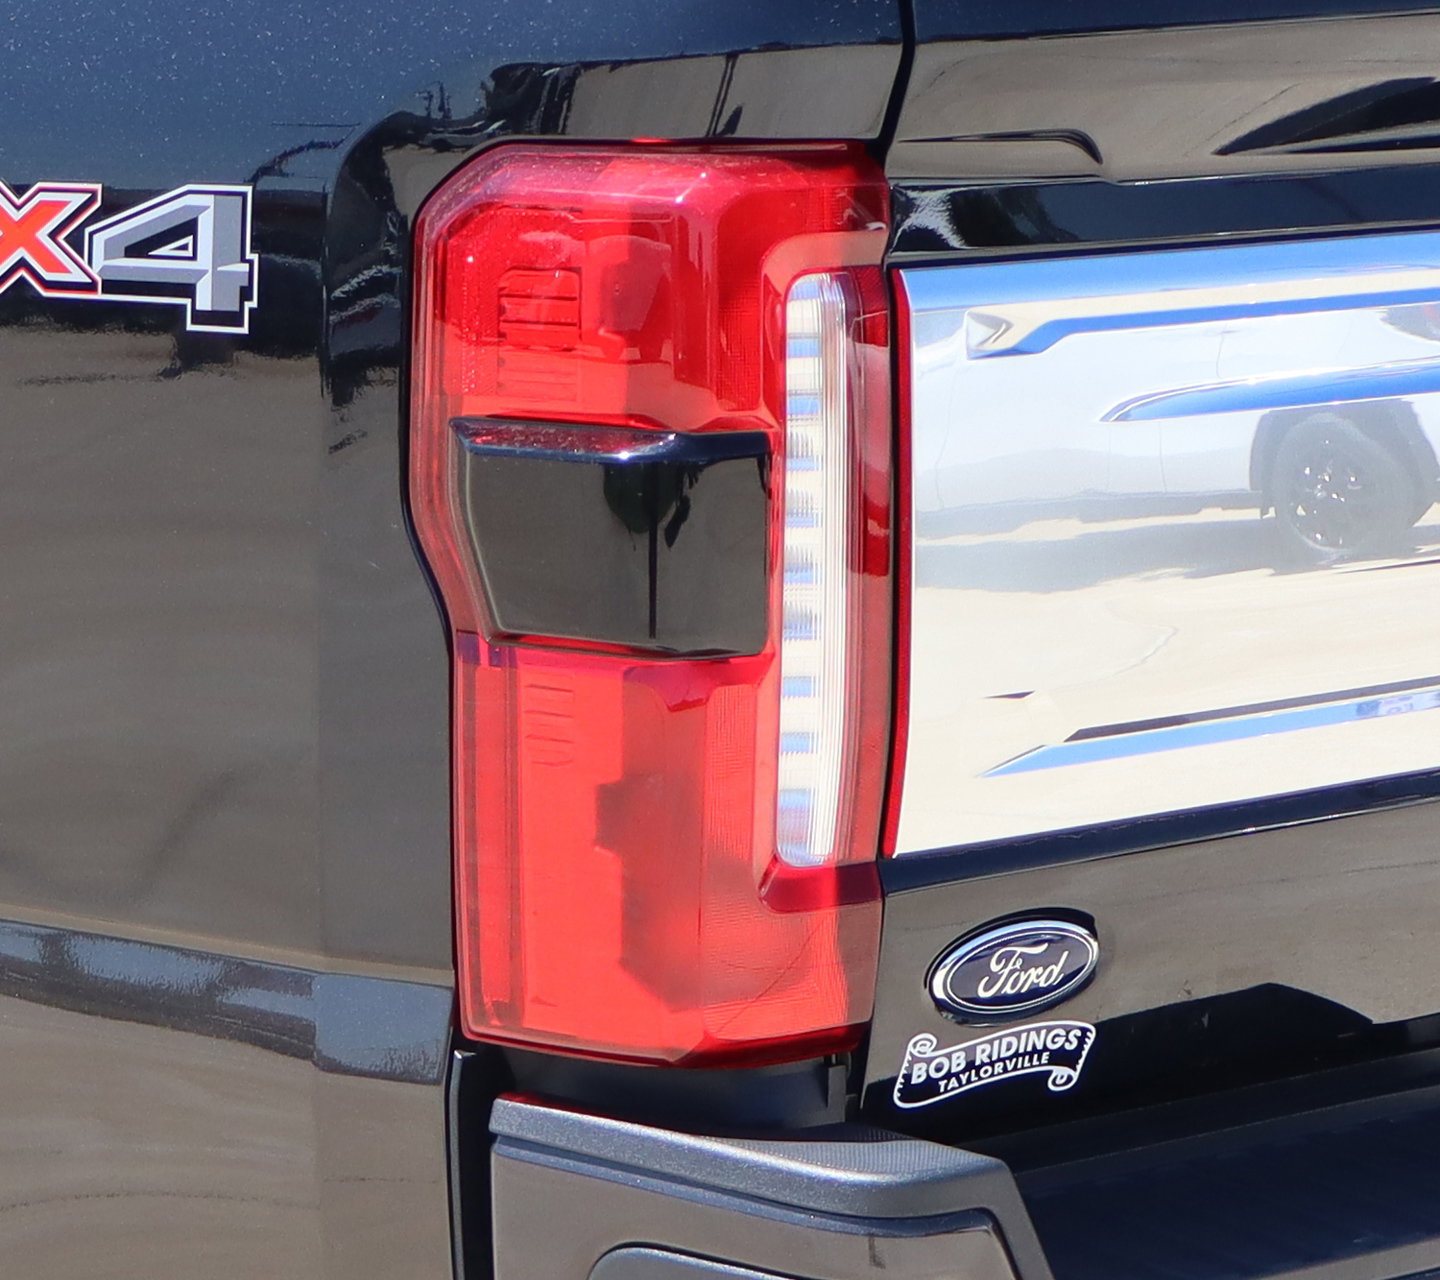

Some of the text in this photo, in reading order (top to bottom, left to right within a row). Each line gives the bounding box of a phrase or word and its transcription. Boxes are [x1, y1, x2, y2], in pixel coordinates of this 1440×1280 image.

[976, 941, 1070, 999] Ford
[910, 1028, 1083, 1086] BOB RIDINGS
[937, 1052, 1051, 1094] TAYLORVILLE
